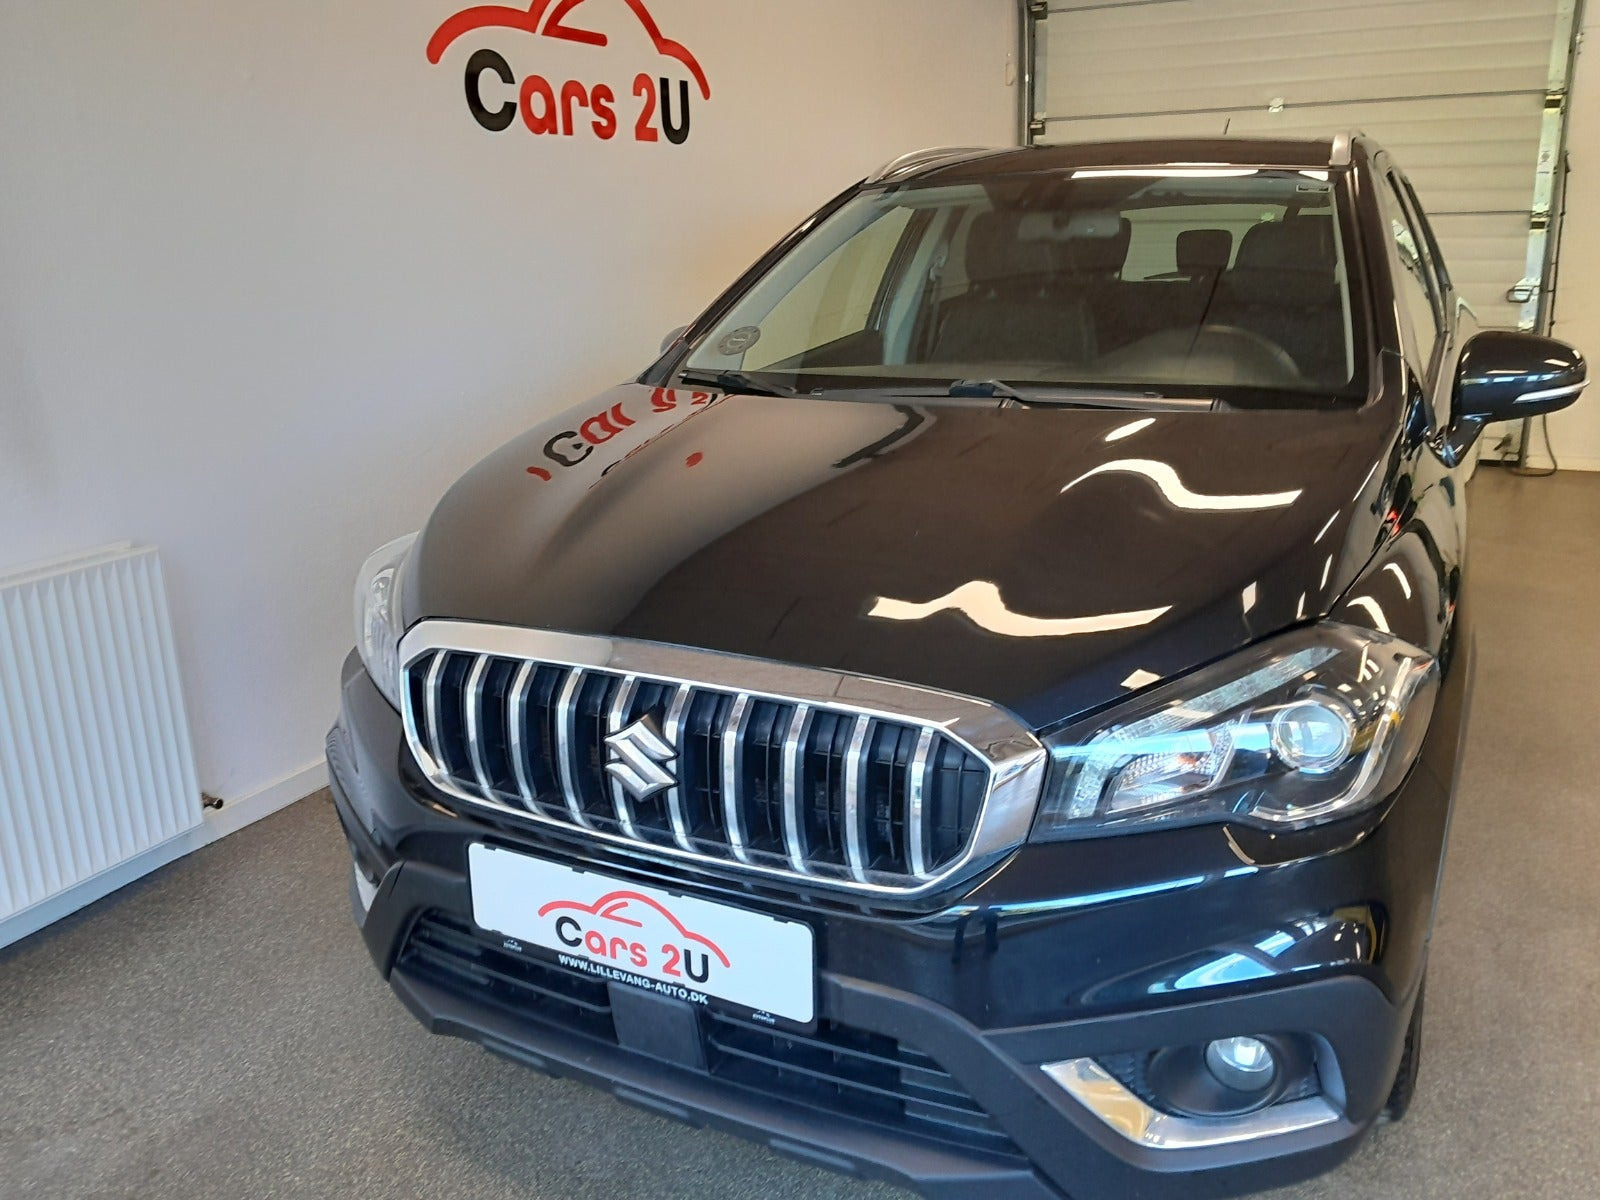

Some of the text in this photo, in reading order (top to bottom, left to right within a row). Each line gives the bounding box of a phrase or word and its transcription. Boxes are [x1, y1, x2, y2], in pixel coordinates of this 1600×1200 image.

[464, 48, 691, 145] Cars 2U
[555, 915, 709, 983] Cars 2U
[558, 953, 709, 1006] WWW.LILLEVANG-AUTO.DK
